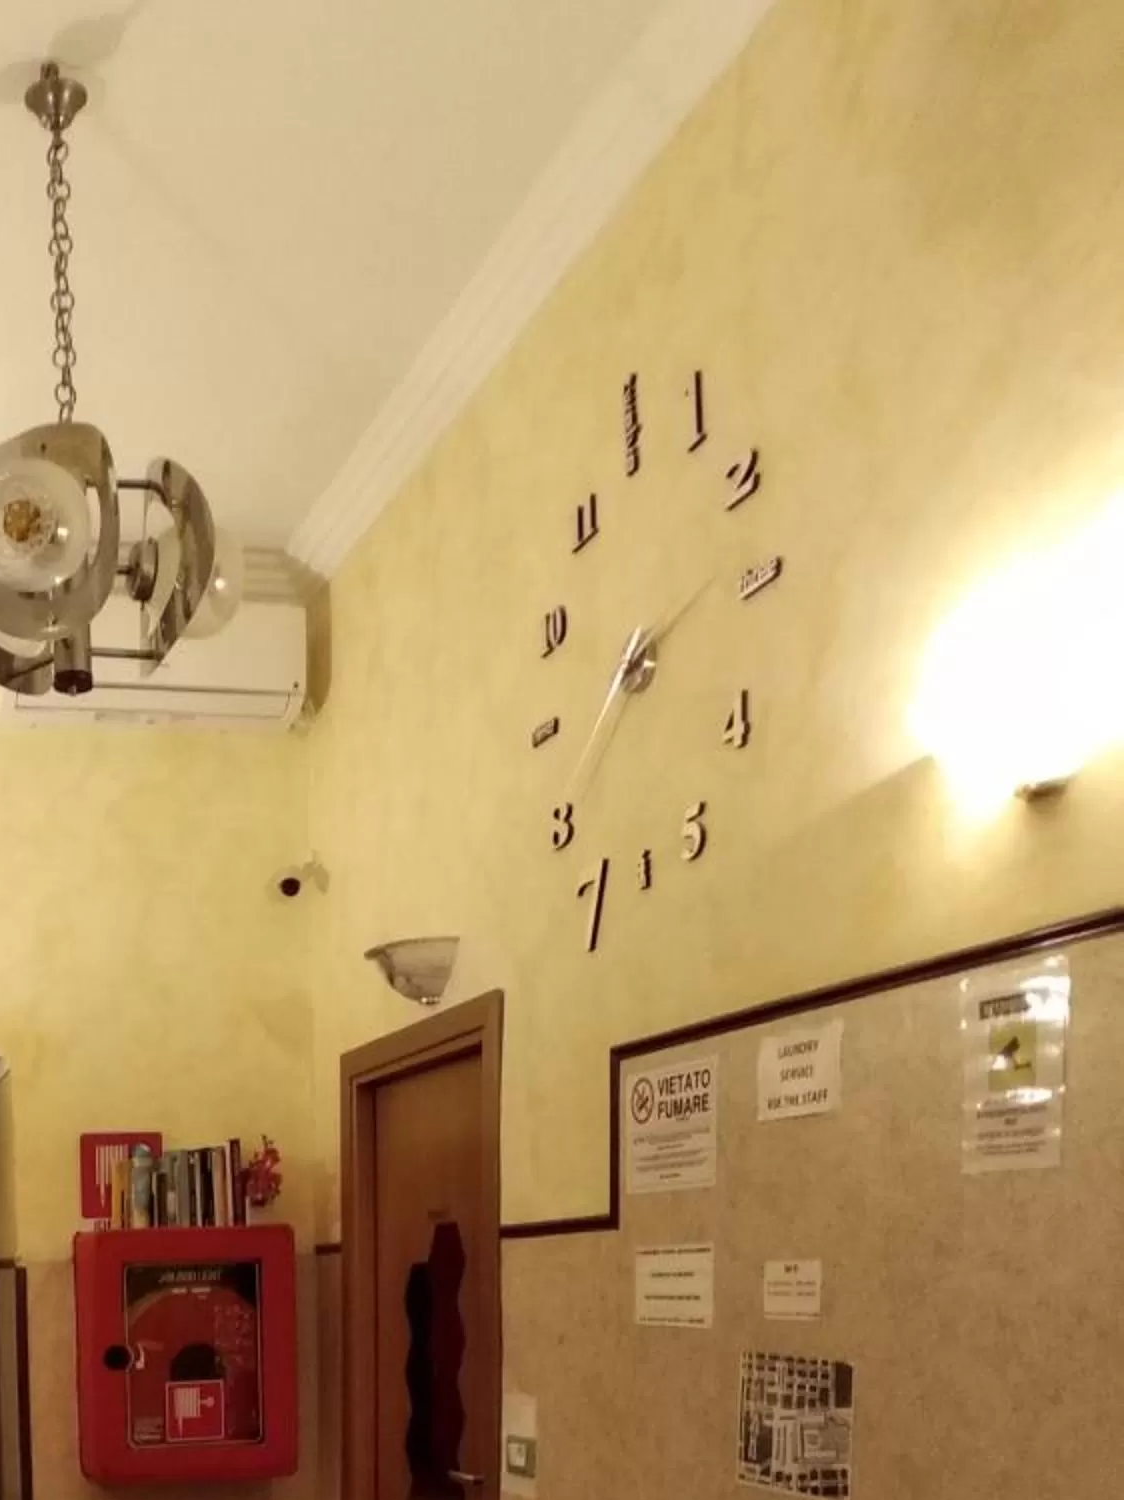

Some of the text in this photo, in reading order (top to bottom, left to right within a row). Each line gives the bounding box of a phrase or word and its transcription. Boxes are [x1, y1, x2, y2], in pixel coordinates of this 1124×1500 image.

[726, 447, 761, 512] 2
[571, 492, 599, 554] 11
[540, 604, 568, 658] 10
[721, 689, 752, 749] 4
[681, 801, 707, 862] 5
[577, 857, 609, 953] 7
[656, 1067, 712, 1097] VIETATO
[656, 1092, 712, 1121] FUMARE
